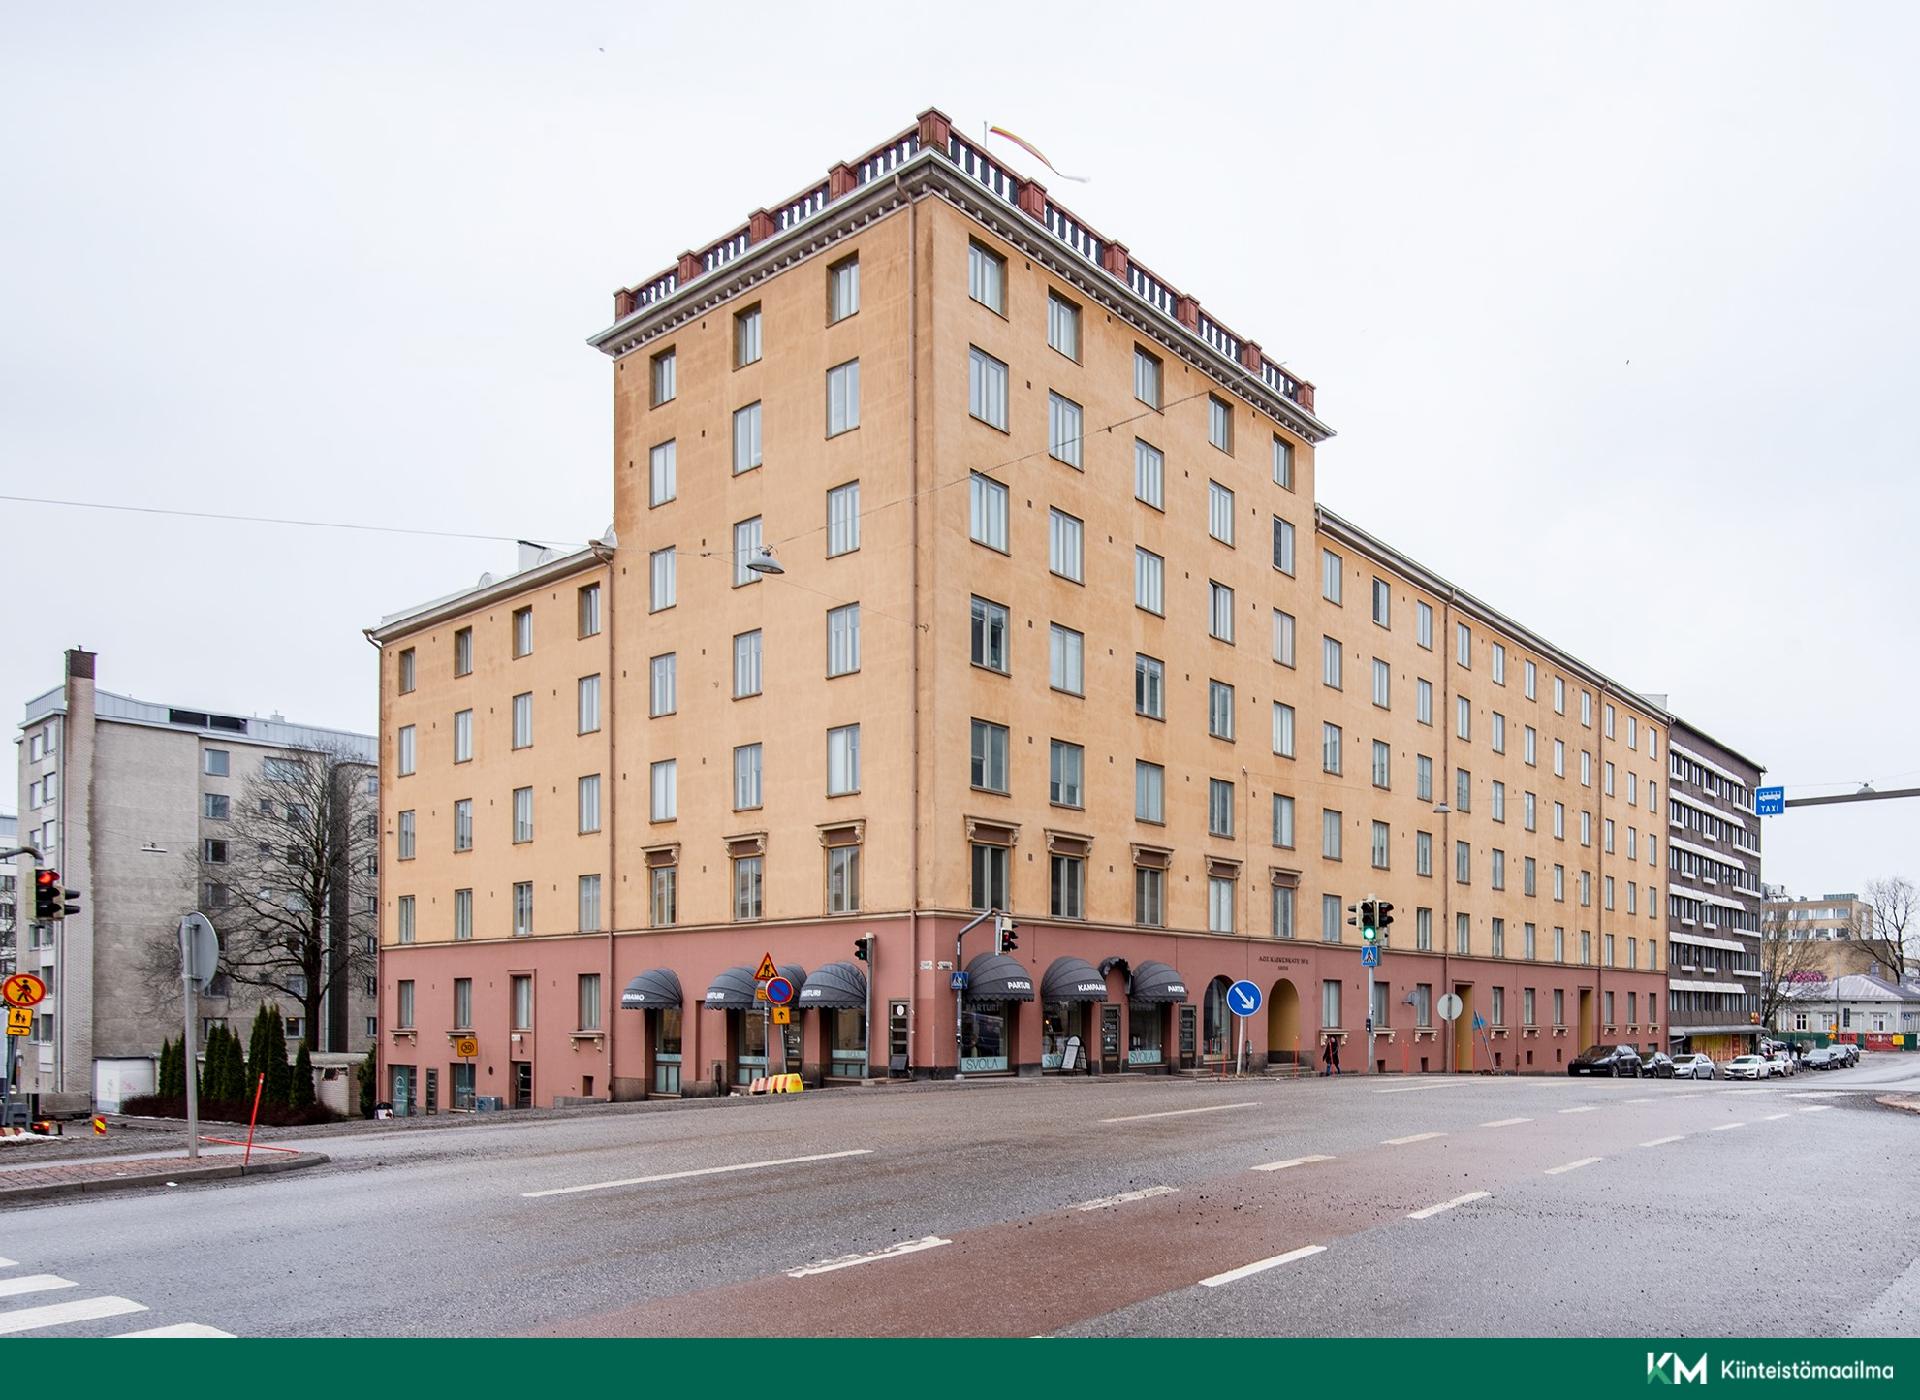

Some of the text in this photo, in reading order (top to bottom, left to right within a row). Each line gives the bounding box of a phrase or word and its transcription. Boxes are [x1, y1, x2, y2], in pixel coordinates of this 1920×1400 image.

[1761, 804, 1779, 812] TAXI
[966, 1057, 999, 1070] SVOLA
[1044, 1055, 1063, 1067] SVO
